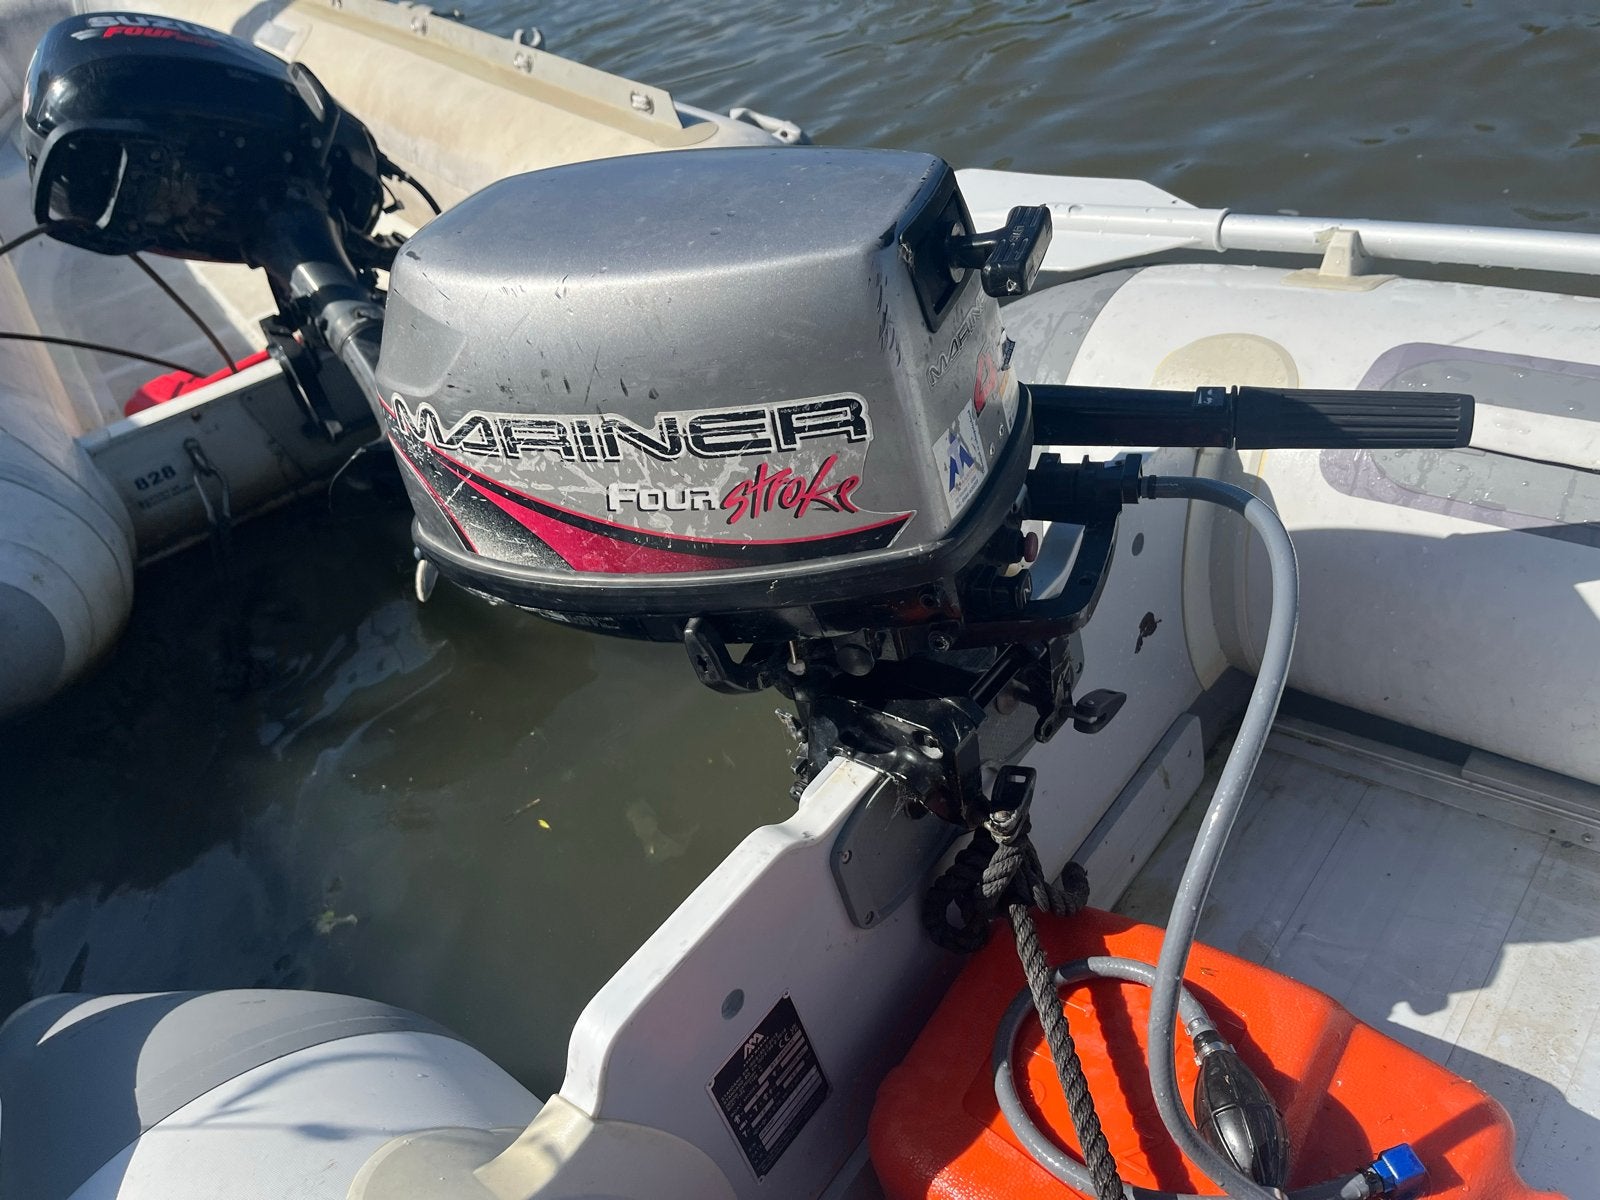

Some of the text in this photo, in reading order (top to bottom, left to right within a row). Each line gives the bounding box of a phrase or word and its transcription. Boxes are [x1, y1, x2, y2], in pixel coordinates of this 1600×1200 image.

[391, 393, 870, 462] MARINER
[606, 454, 860, 525] FOUR stroke
